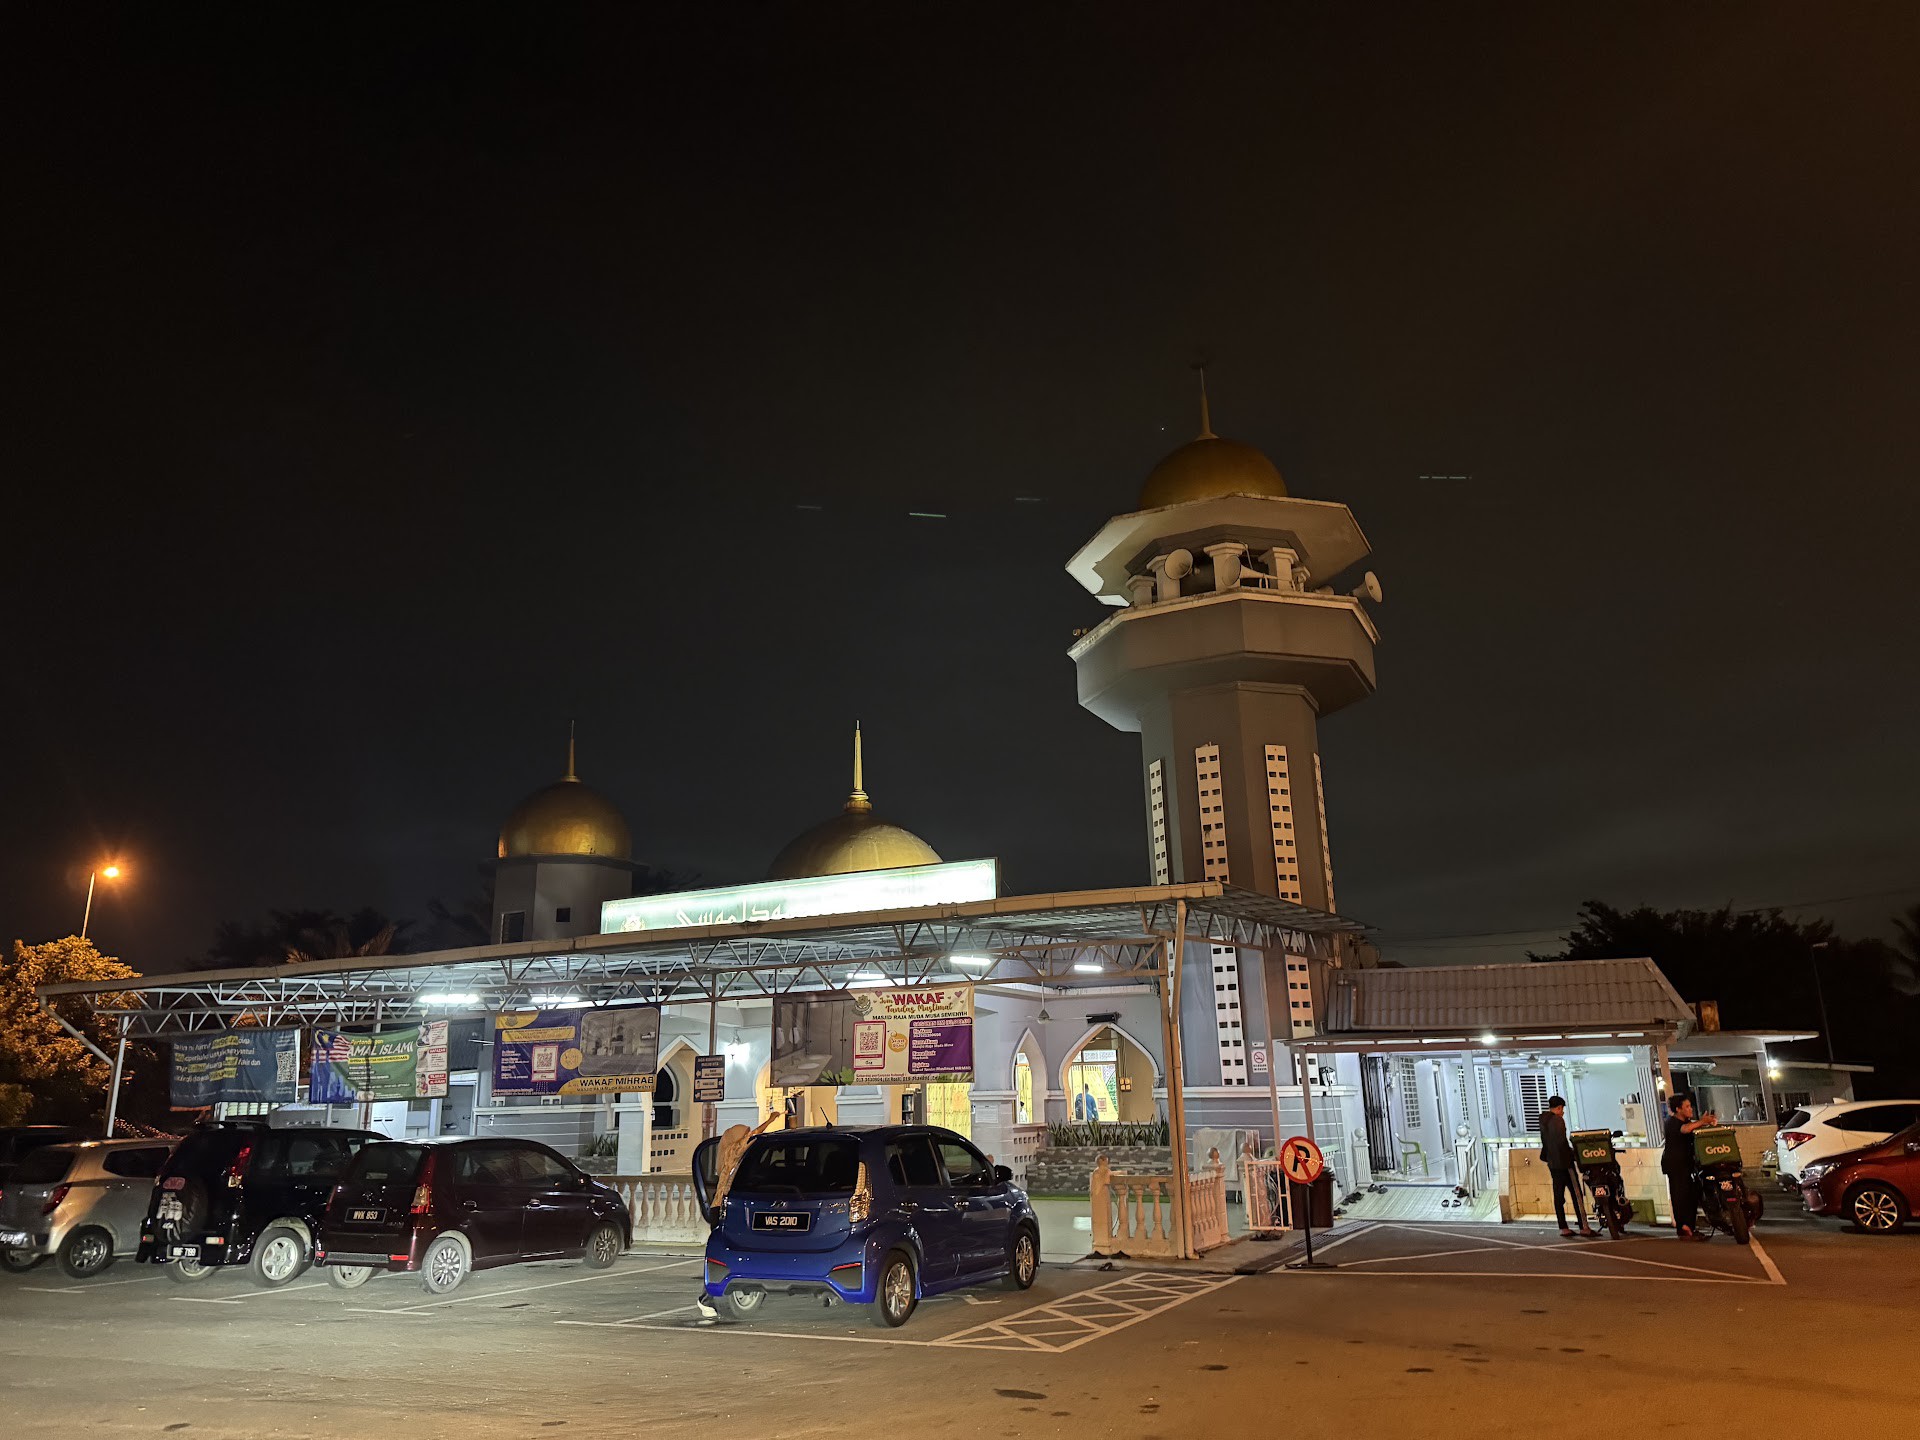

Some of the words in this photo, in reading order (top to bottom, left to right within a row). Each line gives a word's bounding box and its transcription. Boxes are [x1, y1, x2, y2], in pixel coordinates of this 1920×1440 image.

[891, 992, 945, 1005] WAKAF
[885, 1004, 916, 1014] Tandas
[917, 1002, 954, 1013] Muslimat
[347, 1045, 377, 1057] AMAL
[379, 1041, 414, 1055] ISLAMI
[579, 1079, 613, 1087] WAKAF
[615, 1077, 653, 1085] MIHRAB
[1582, 1147, 1607, 1158] Grab
[1705, 1144, 1731, 1155] Grab
[765, 1216, 778, 1226] VAS
[779, 1216, 798, 1226] 2010
